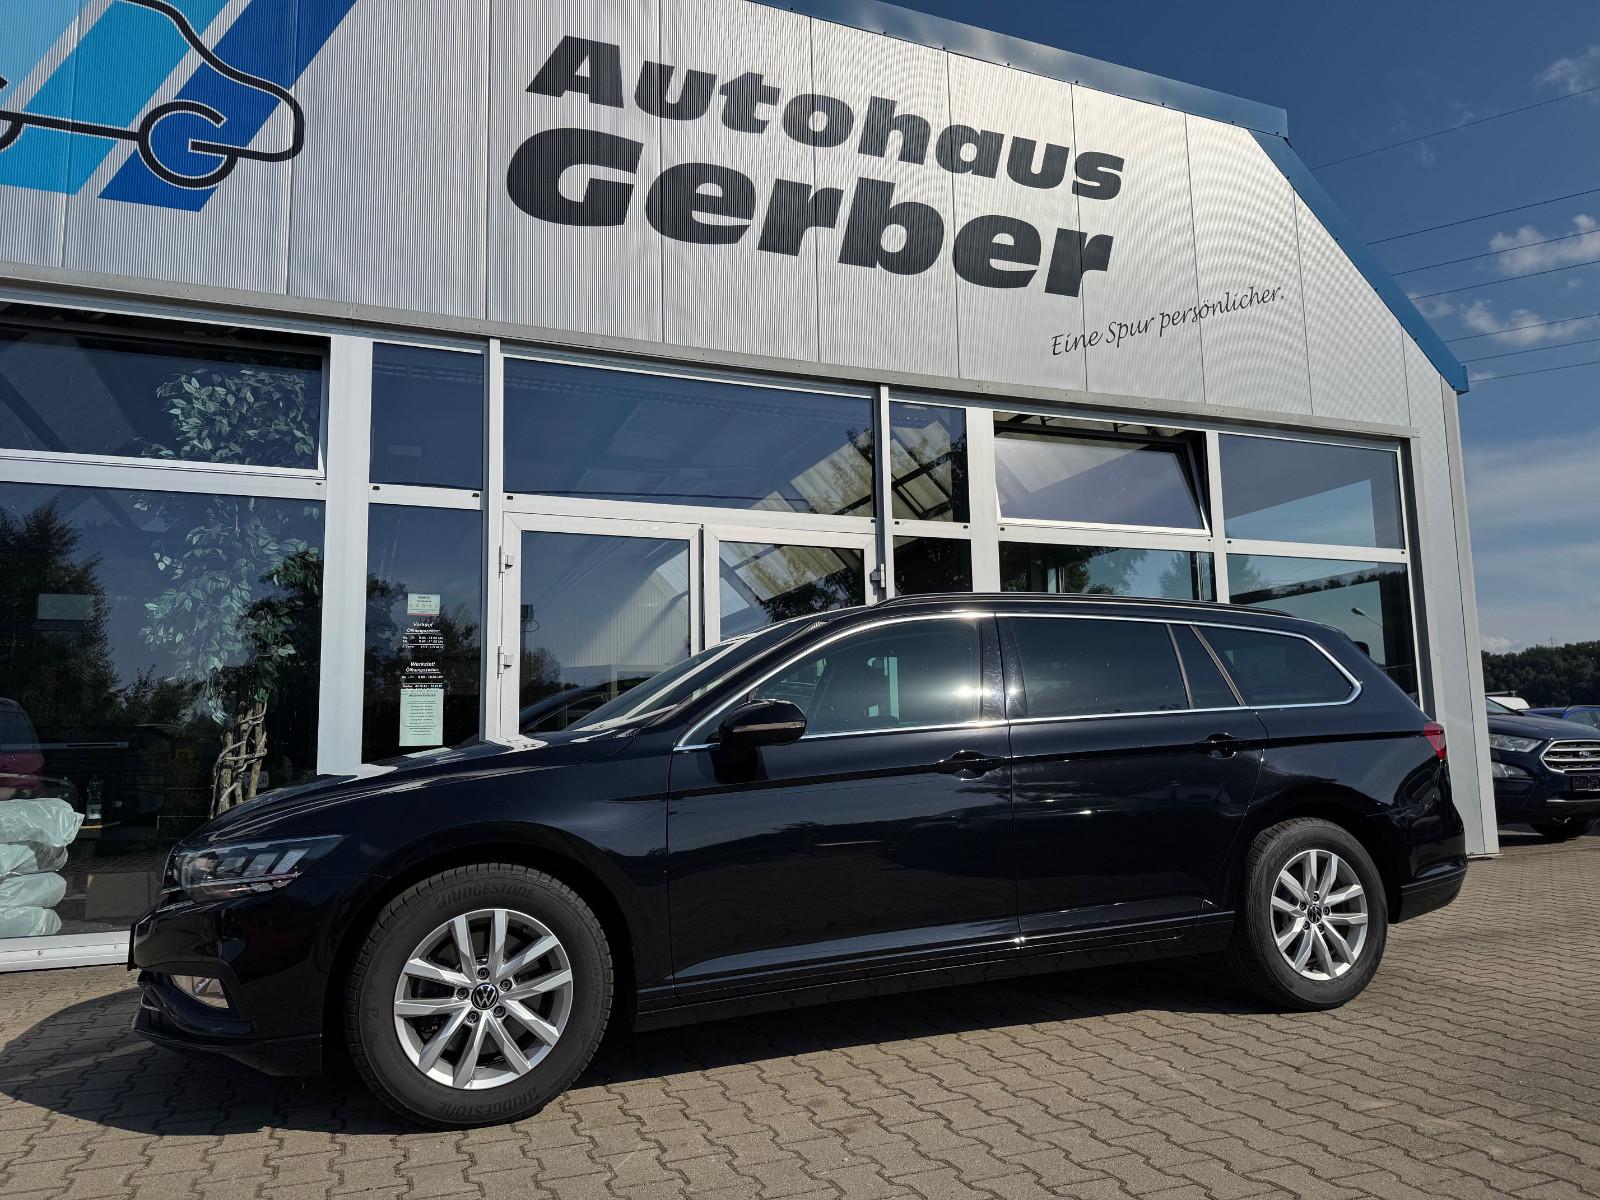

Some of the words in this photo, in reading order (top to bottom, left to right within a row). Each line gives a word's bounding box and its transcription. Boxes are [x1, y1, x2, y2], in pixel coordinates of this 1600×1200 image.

[525, 35, 1124, 200] Autohaus
[506, 127, 1114, 297] Gerber
[1051, 330, 1103, 356] Eine
[1105, 315, 1155, 348] Spur
[1159, 286, 1285, 337] persönlicher.
